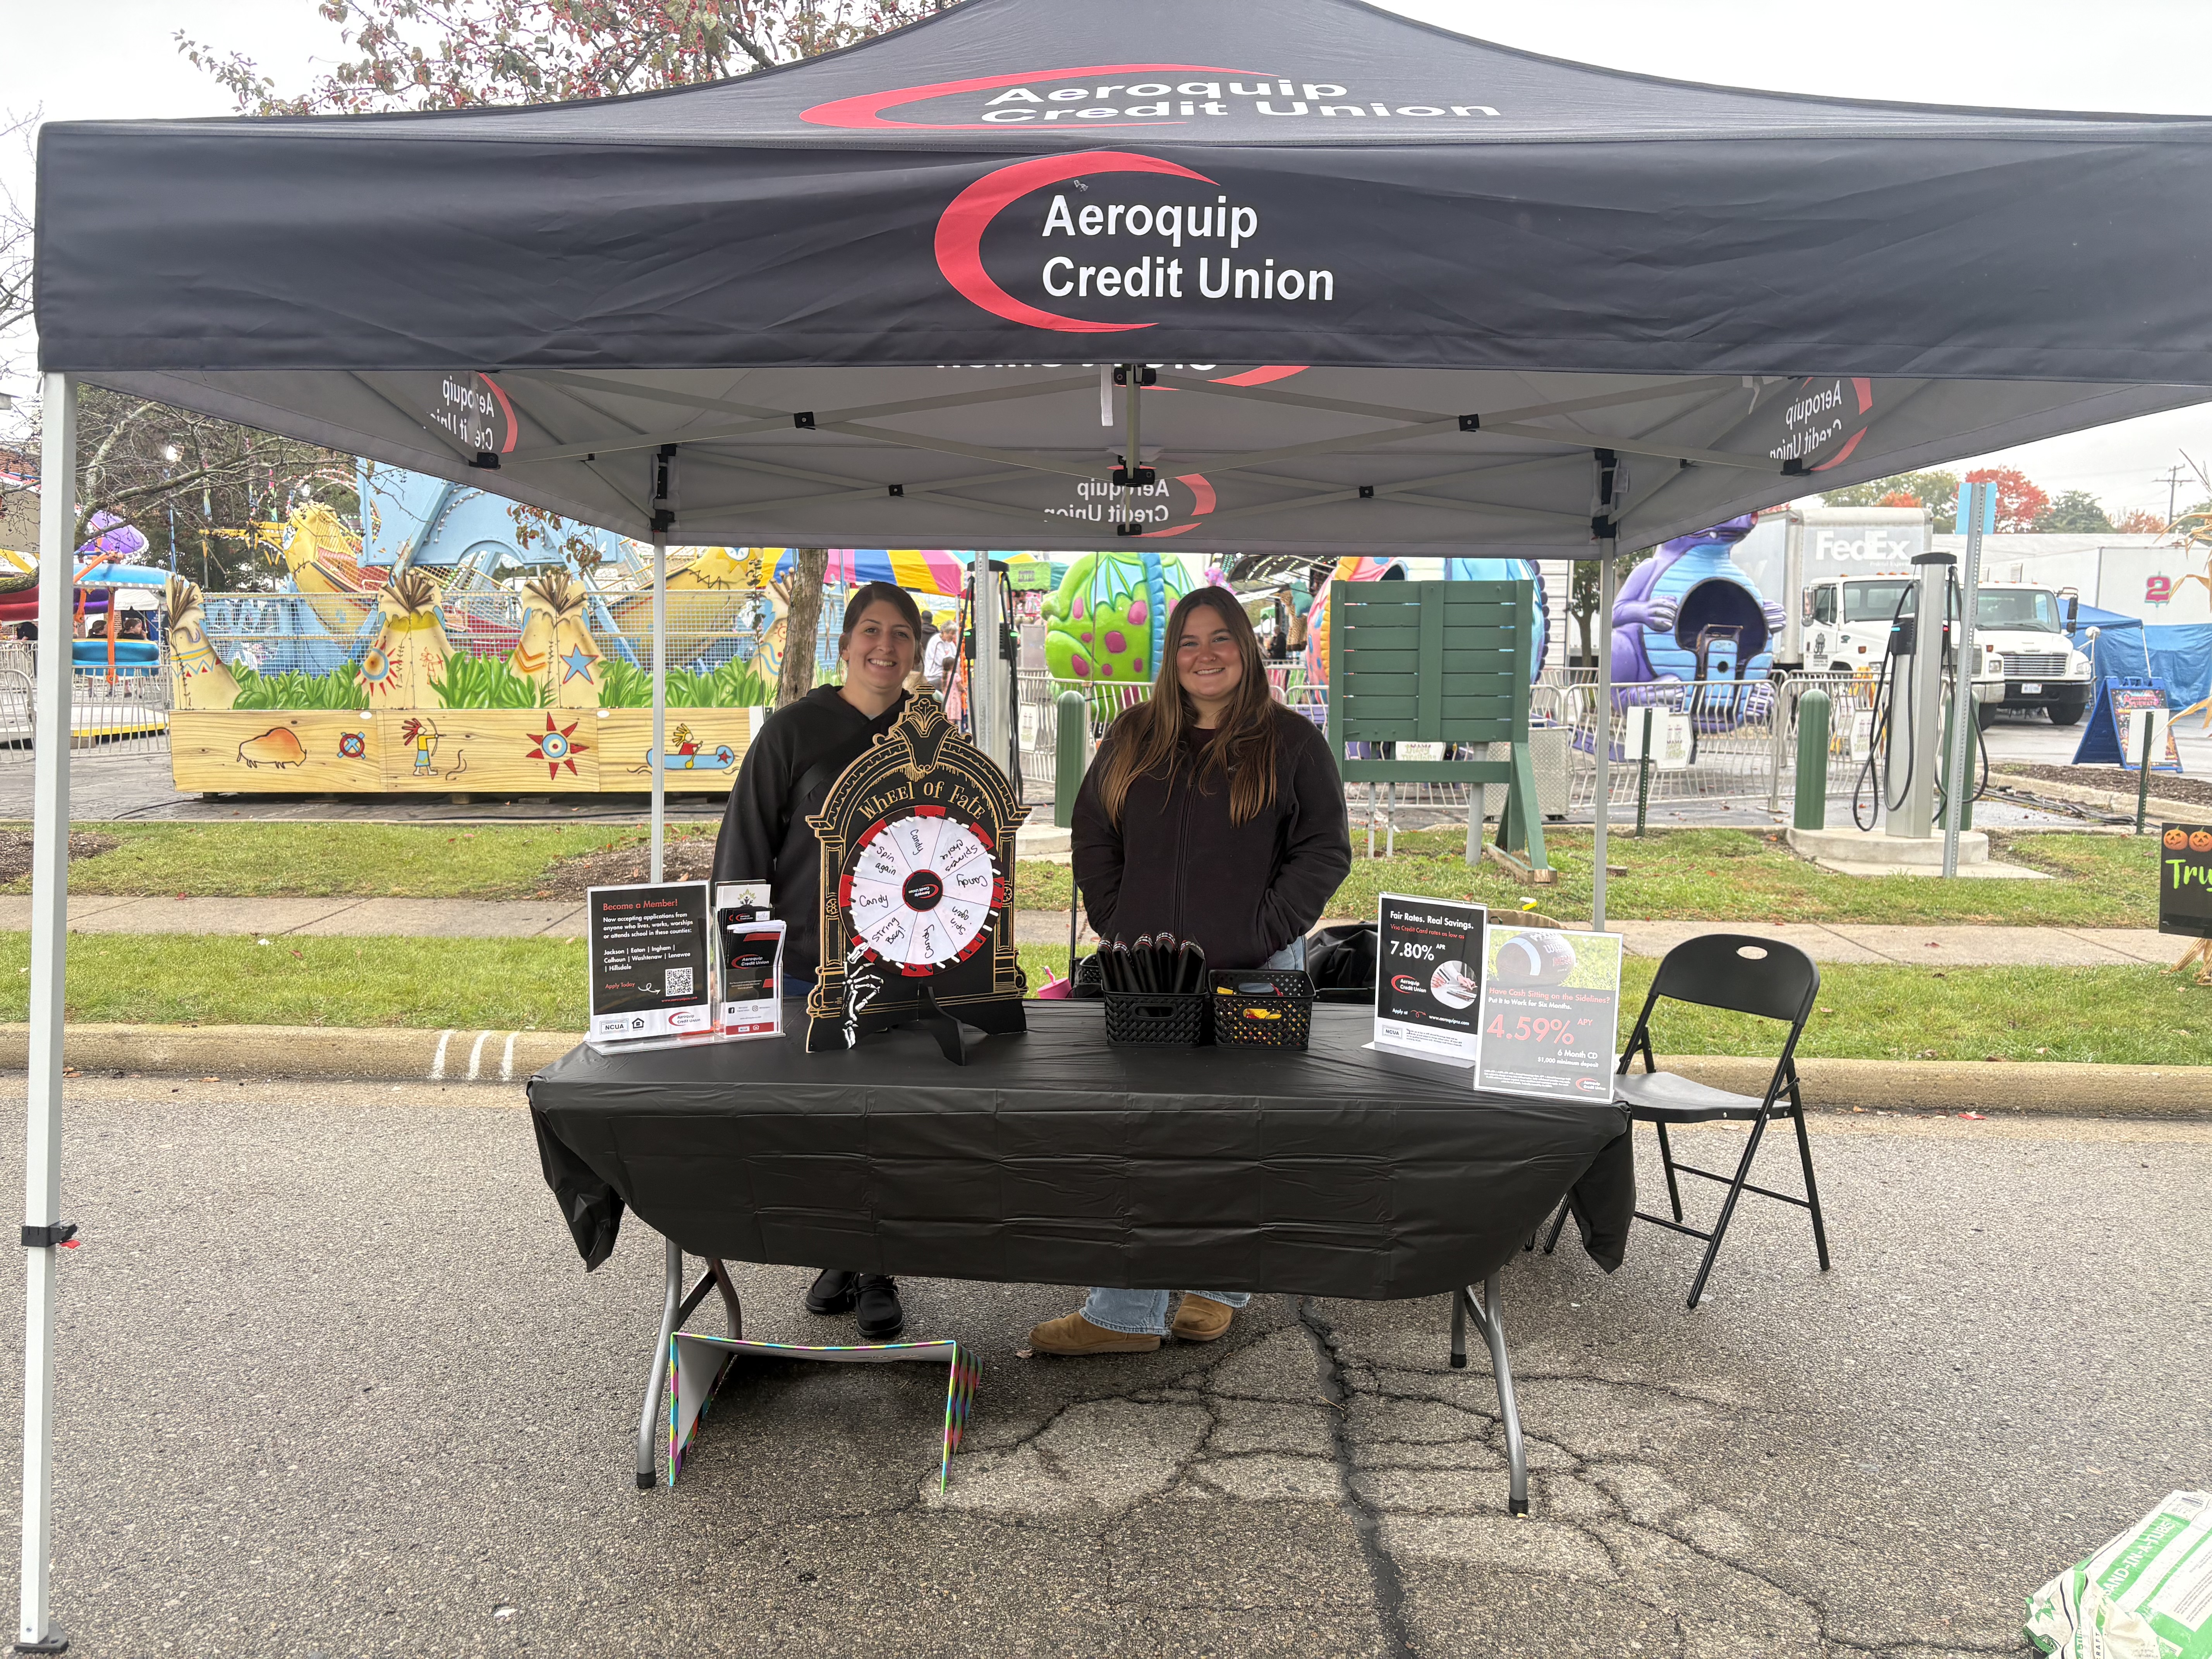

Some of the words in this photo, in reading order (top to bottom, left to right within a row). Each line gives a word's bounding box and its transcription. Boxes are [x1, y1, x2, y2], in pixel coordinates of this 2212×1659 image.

[984, 79, 1348, 105] Aeroquip
[981, 100, 1228, 122] Credit
[1255, 101, 1501, 117] Union
[1042, 195, 1257, 248] Aeroquip
[1042, 256, 1182, 297] Credit
[1199, 258, 1333, 301] Union
[1816, 530, 1910, 561] FedEx
[2145, 576, 2171, 603] 2
[924, 781, 945, 799] of
[910, 829, 924, 855] Candy
[877, 846, 894, 862] Spin
[875, 862, 896, 875] again
[956, 874, 988, 888] Candy
[643, 899, 678, 908] Member!
[859, 894, 889, 908] Candy
[644, 913, 674, 921] applications
[952, 906, 969, 921] again
[1390, 911, 1403, 919] Fair
[1405, 913, 1425, 923] Rates.
[1427, 915, 1442, 925] Real
[1444, 917, 1474, 931] Savings.
[872, 917, 900, 942] String
[950, 918, 966, 935] Spin
[922, 924, 934, 958] Candy
[1391, 940, 1434, 961] 7.80%
[1509, 989, 1525, 997] Cash
[1528, 991, 1549, 1000] Sitting
[1575, 994, 1610, 1003] Sidelines?
[1487, 1014, 1574, 1045] 4.59%
[1564, 1049, 1586, 1059] Month
